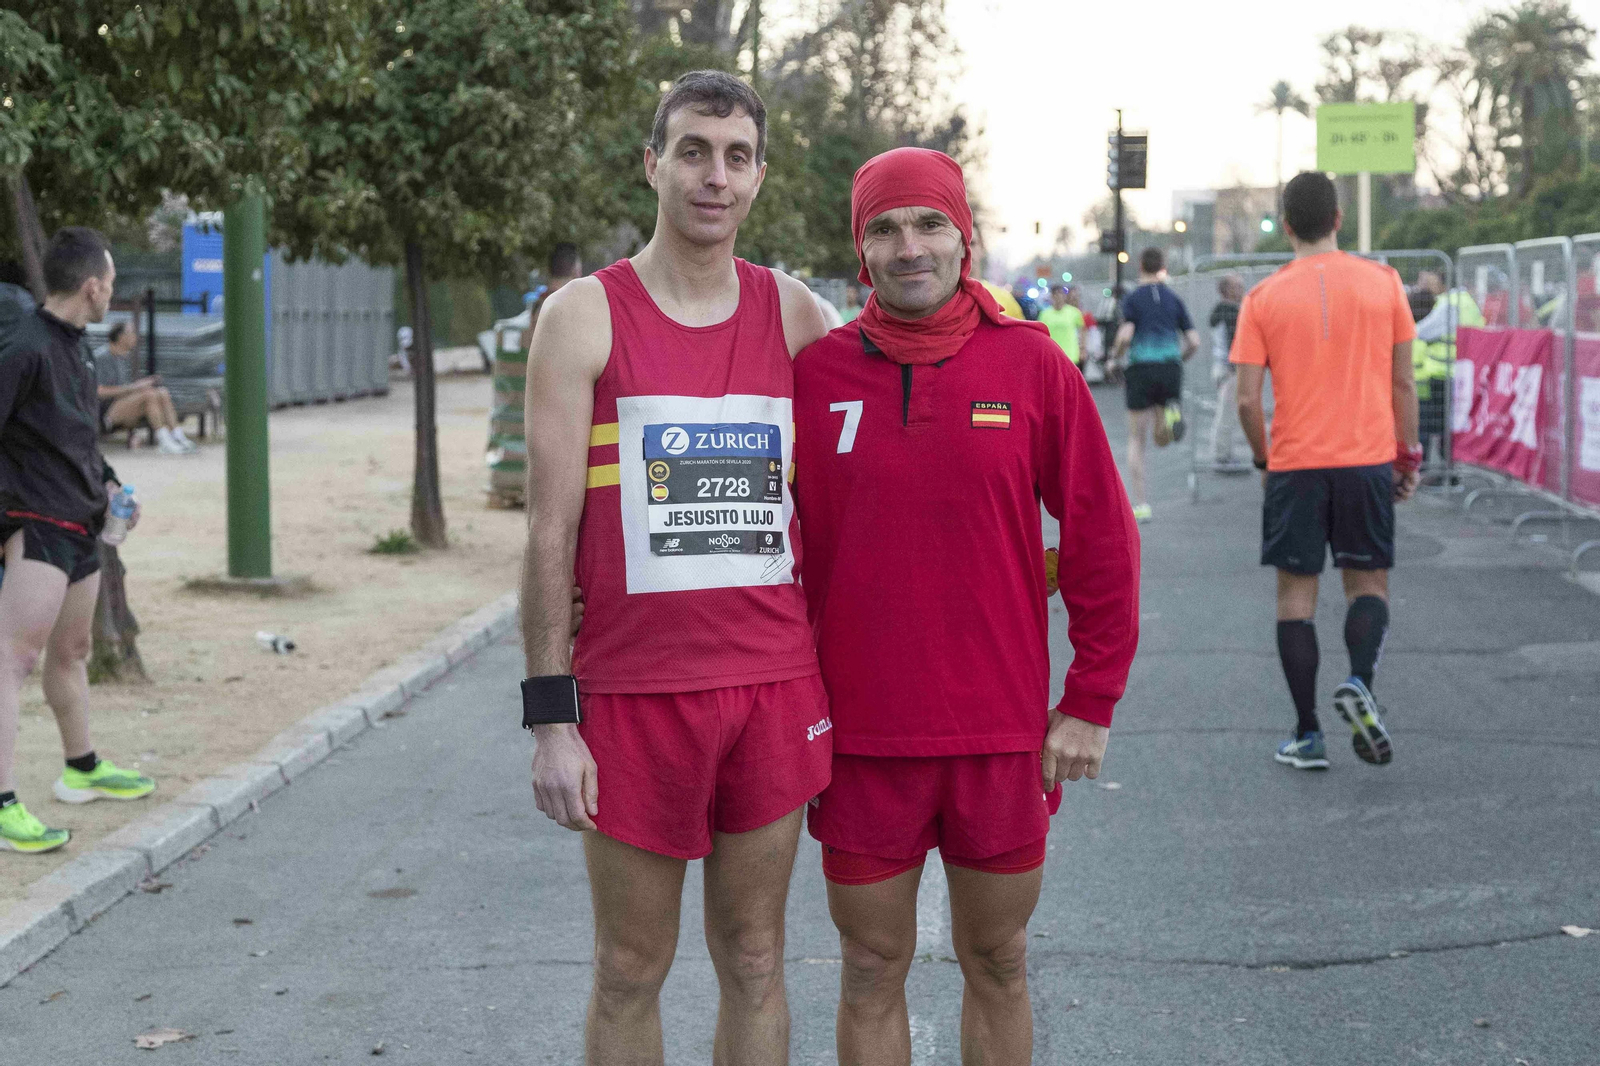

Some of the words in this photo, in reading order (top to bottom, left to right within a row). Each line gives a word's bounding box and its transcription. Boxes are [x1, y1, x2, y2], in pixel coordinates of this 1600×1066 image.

[829, 400, 864, 454] 7
[695, 433, 770, 450] ZURICH
[697, 477, 751, 498] 2728
[663, 509, 739, 527] JESUSITO
[743, 509, 774, 526] LUJO
